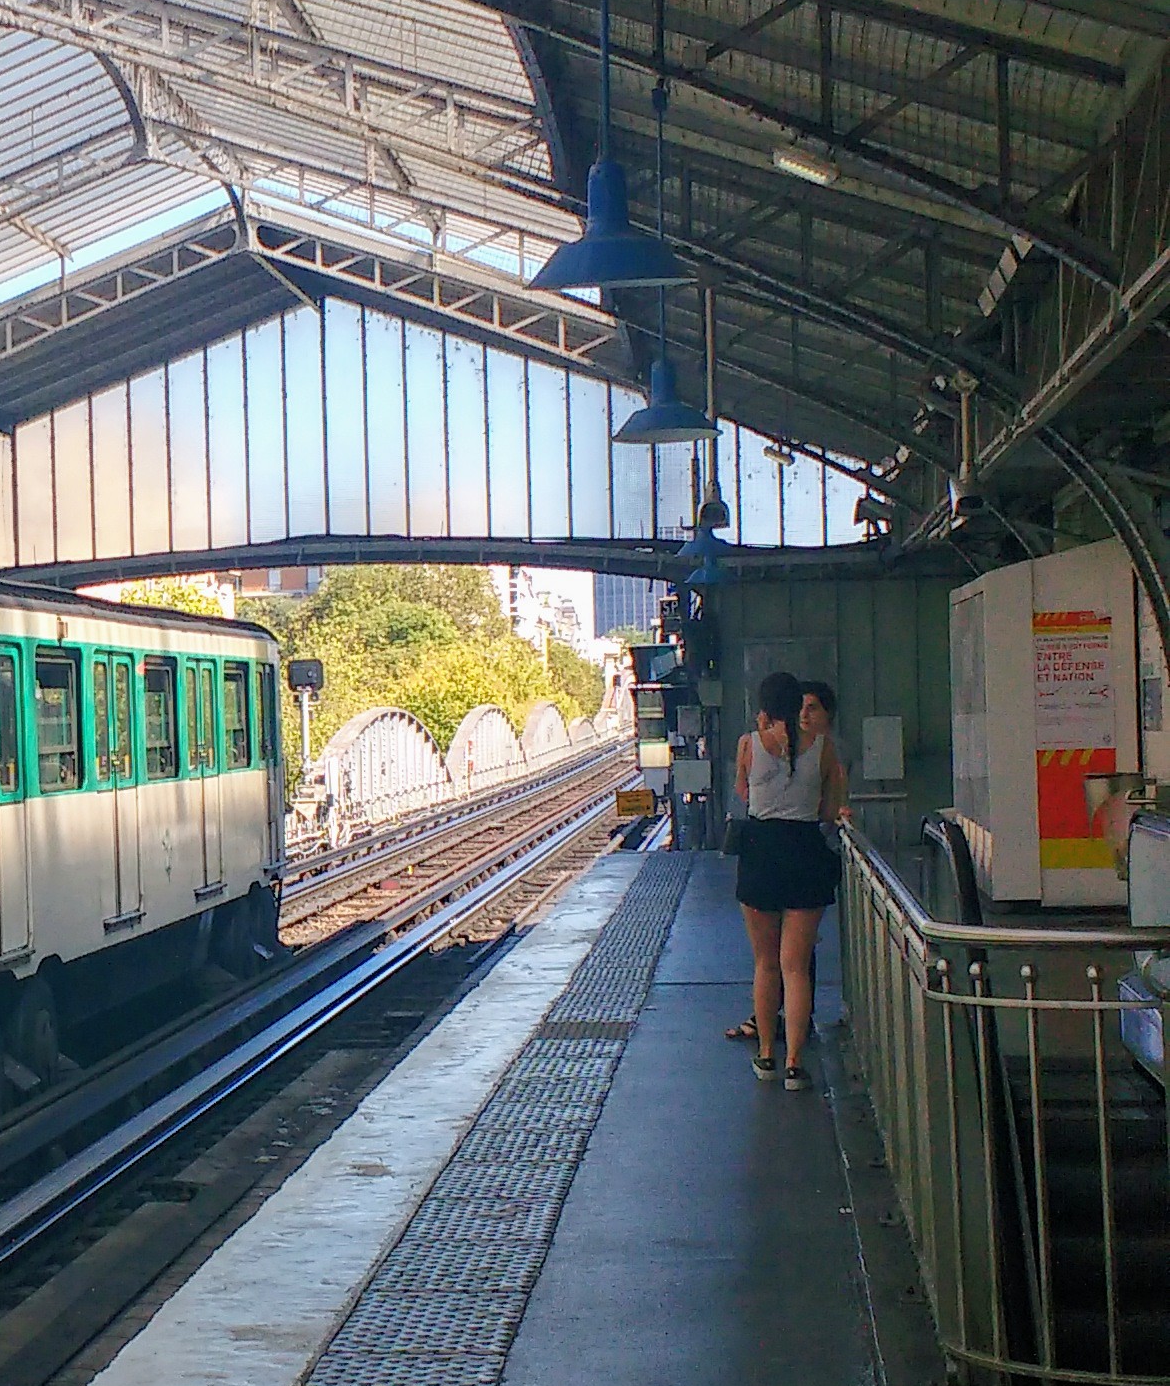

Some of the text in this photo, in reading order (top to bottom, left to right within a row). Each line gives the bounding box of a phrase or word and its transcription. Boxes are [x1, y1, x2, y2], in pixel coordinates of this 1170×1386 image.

[1037, 652, 1072, 661] ENTRE
[1037, 663, 1051, 672] LA
[1037, 673, 1094, 683] ET NATION
